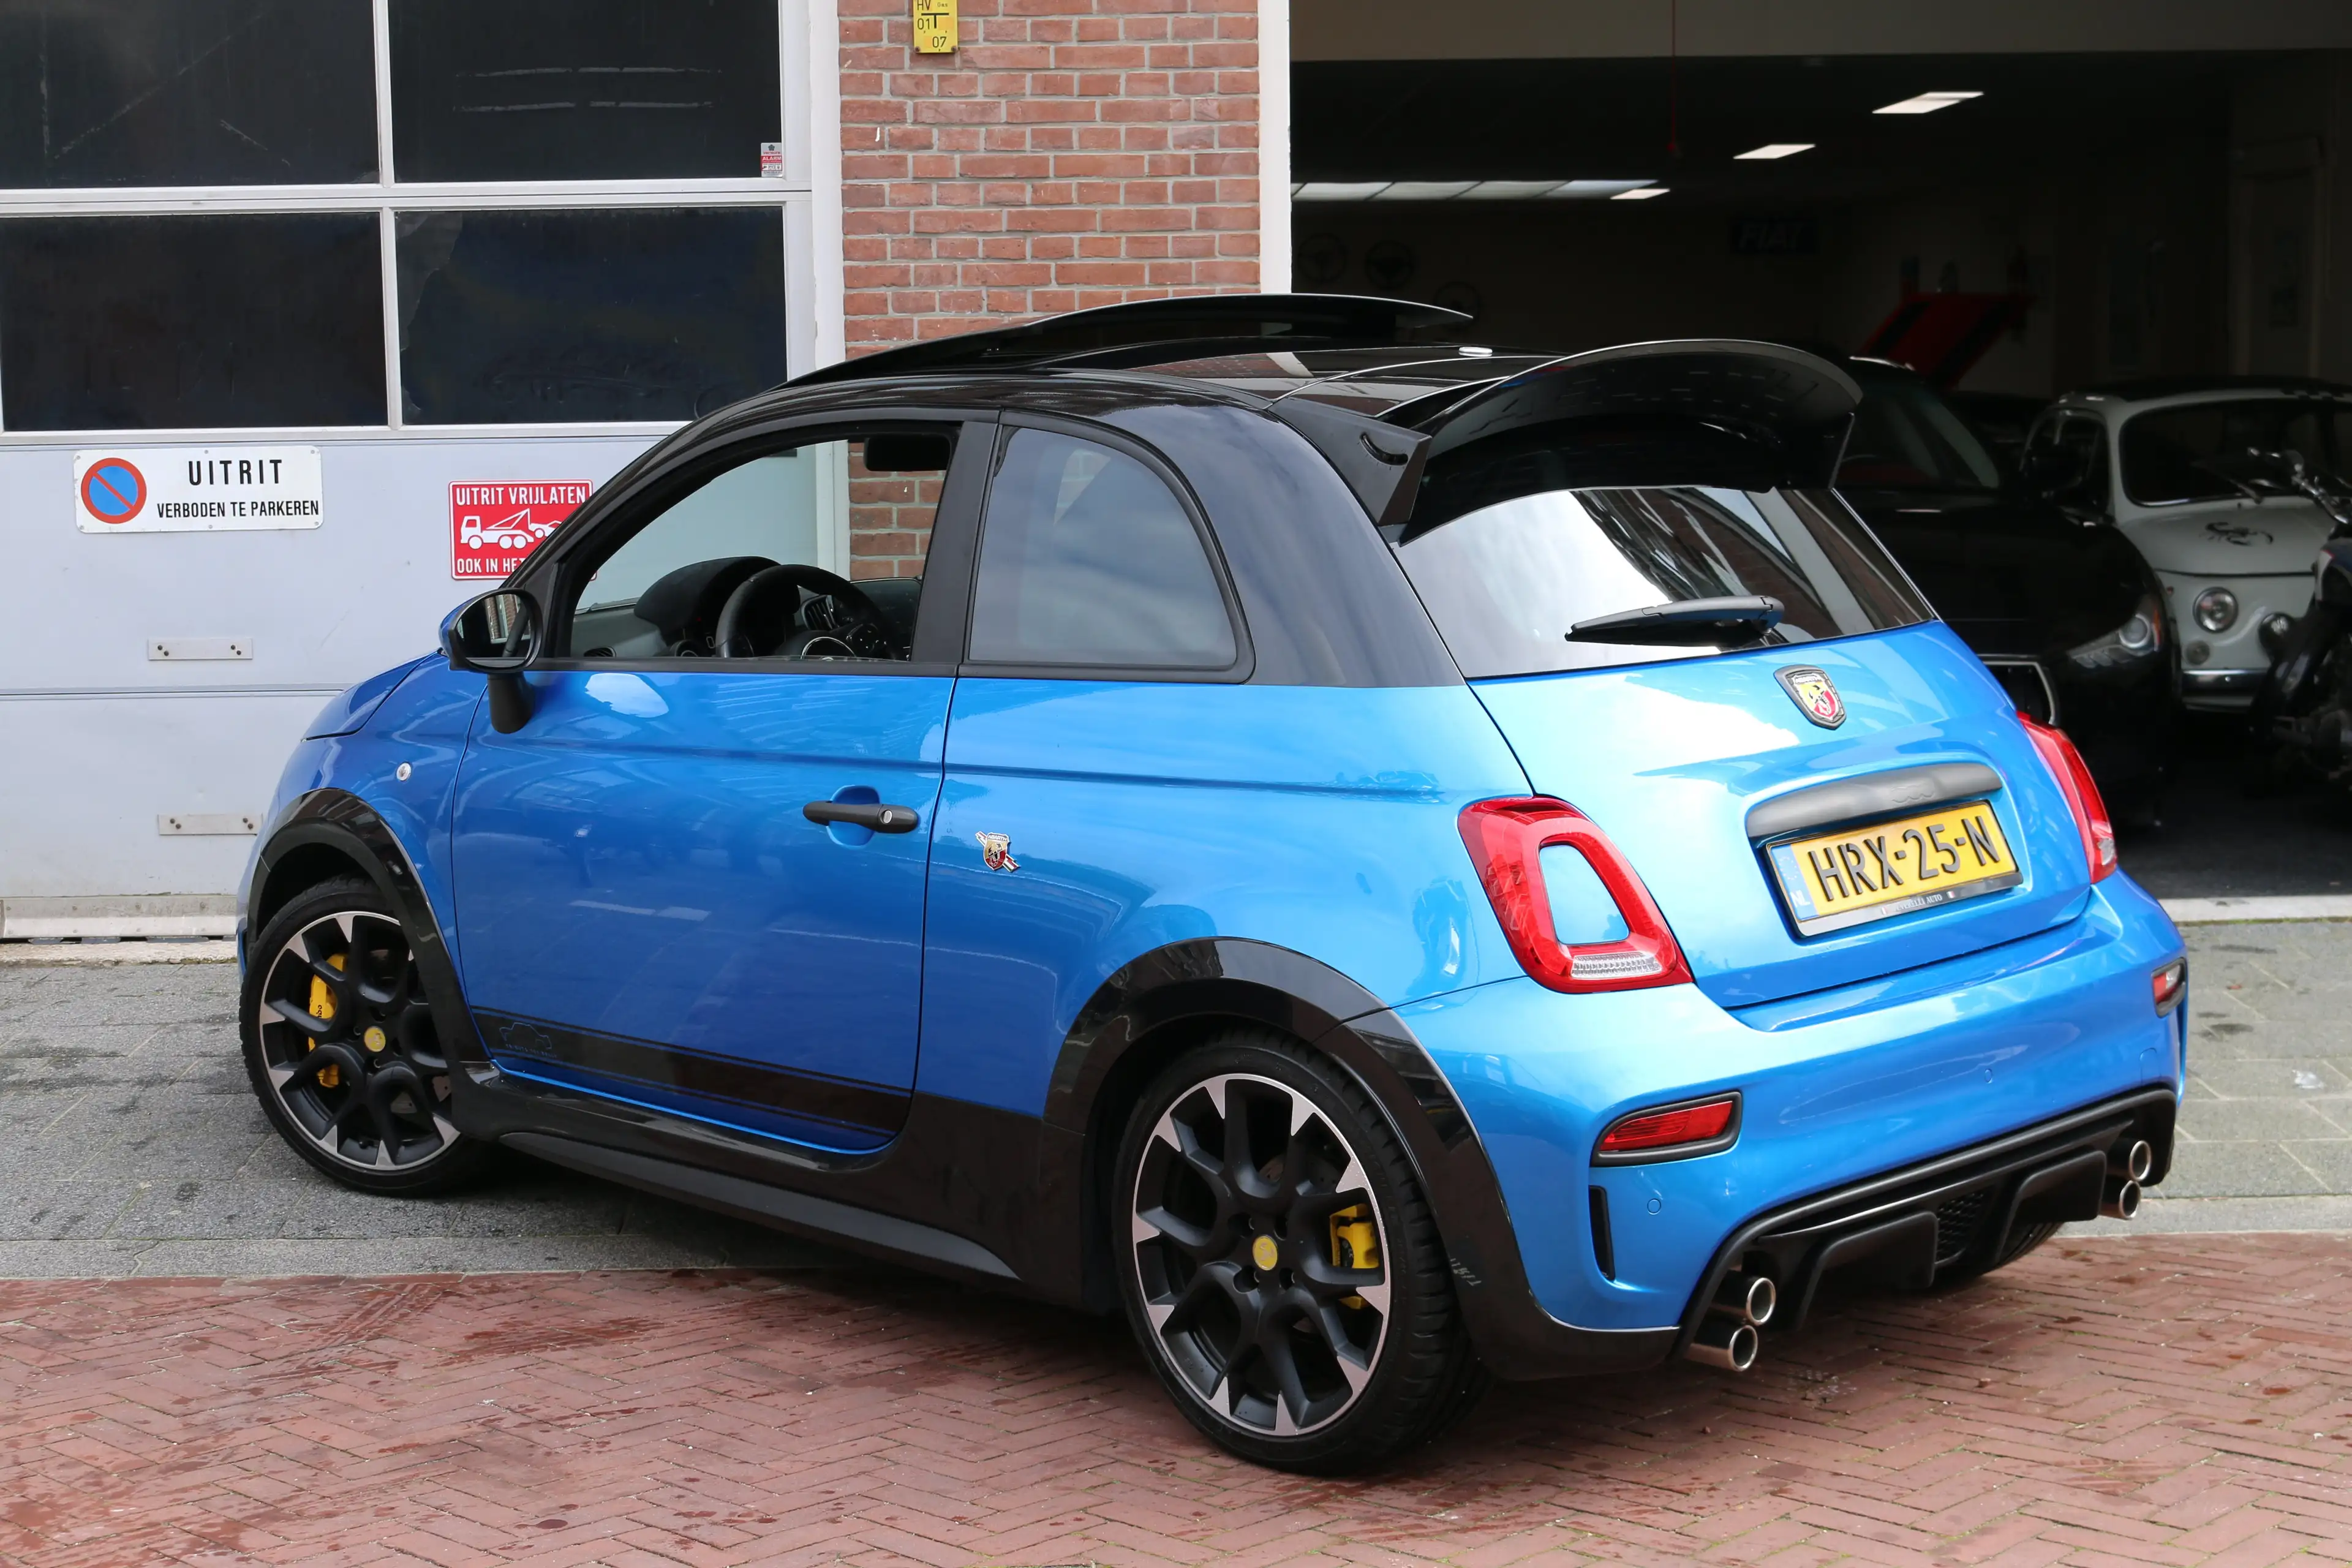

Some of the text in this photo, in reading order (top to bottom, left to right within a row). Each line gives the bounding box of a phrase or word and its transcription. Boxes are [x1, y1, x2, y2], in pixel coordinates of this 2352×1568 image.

[1739, 224, 1805, 251] FIAT
[189, 459, 282, 486] UITRIT
[456, 486, 586, 506] UITRIT VRIJLATEN
[157, 500, 319, 518] VERBODEN TE PARKEREN
[457, 558, 482, 574] OOK
[486, 558, 499, 573] IN
[1807, 815, 2001, 902] HRX-25-N
[1791, 891, 1811, 907] NL
[1926, 894, 1943, 904] AUTO
